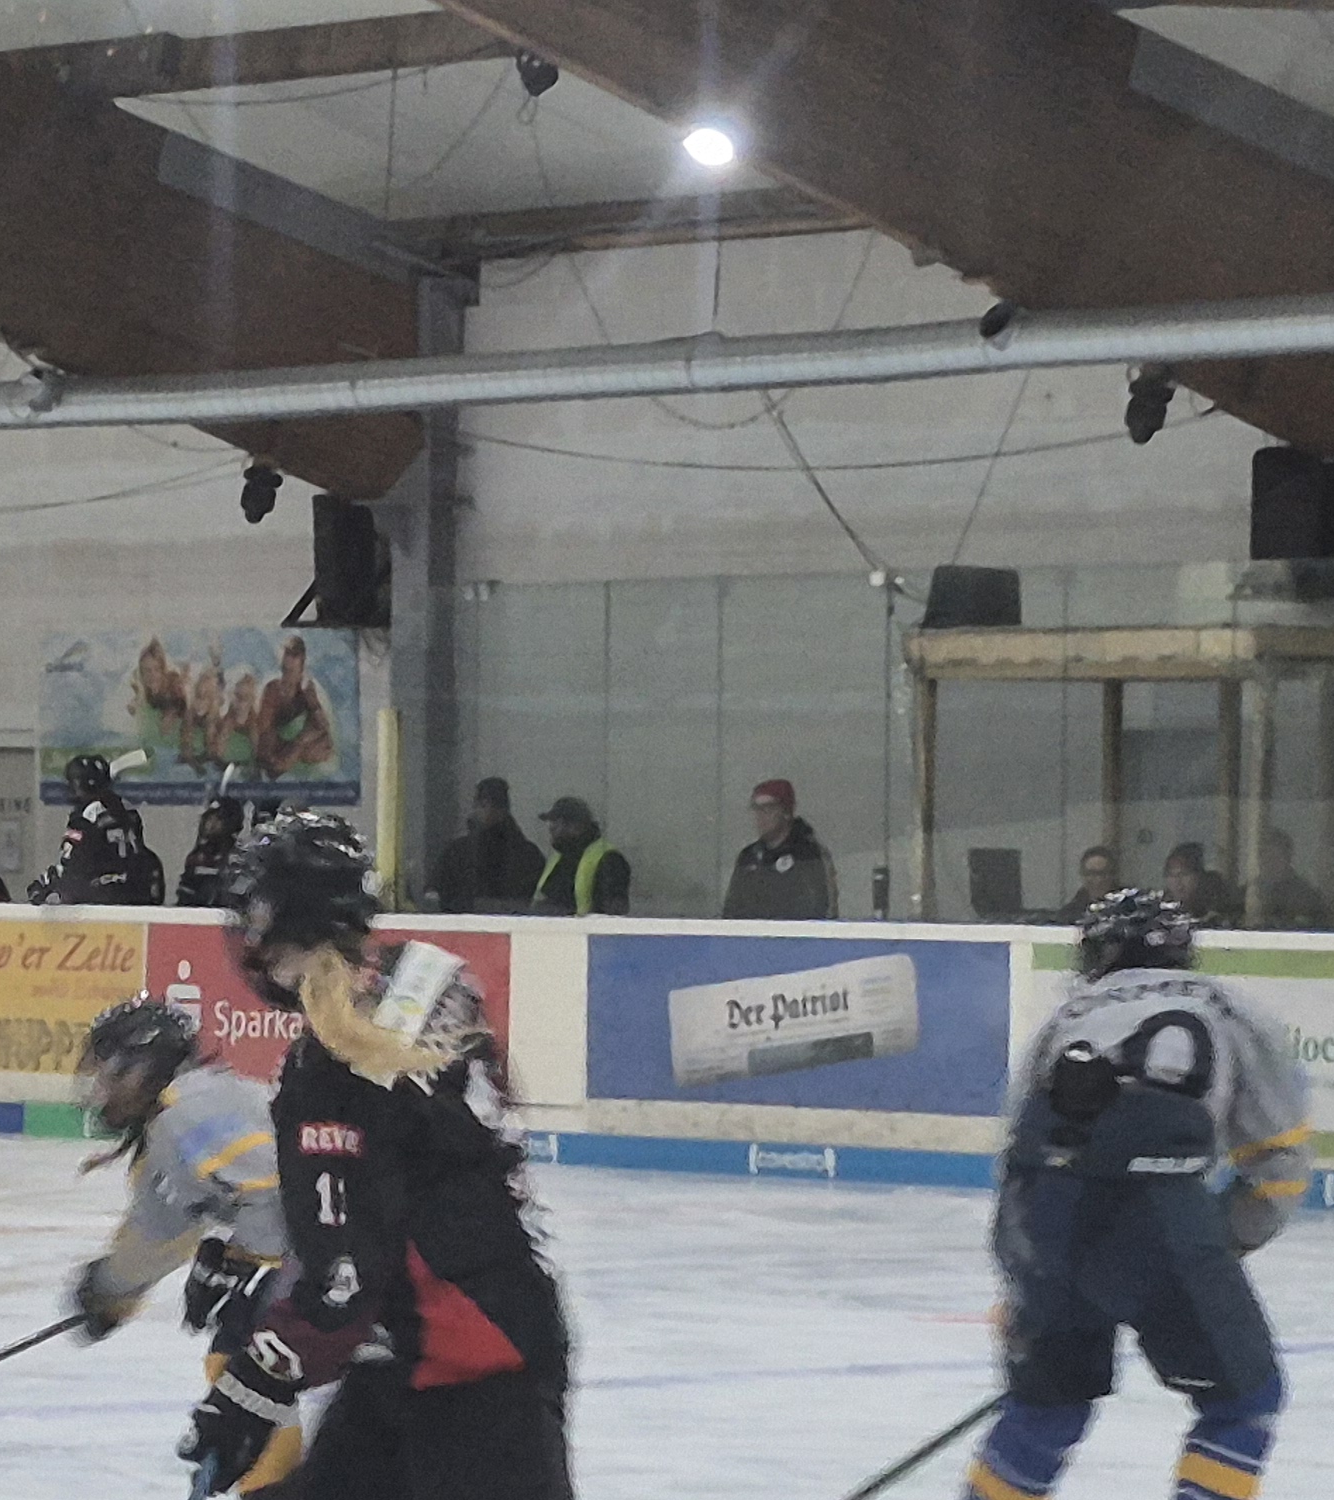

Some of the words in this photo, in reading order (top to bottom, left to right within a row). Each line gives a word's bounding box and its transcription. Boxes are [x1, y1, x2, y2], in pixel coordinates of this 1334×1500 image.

[56, 932, 136, 974] Zelte
[726, 998, 766, 1030] Der
[769, 987, 849, 1031] Patriot
